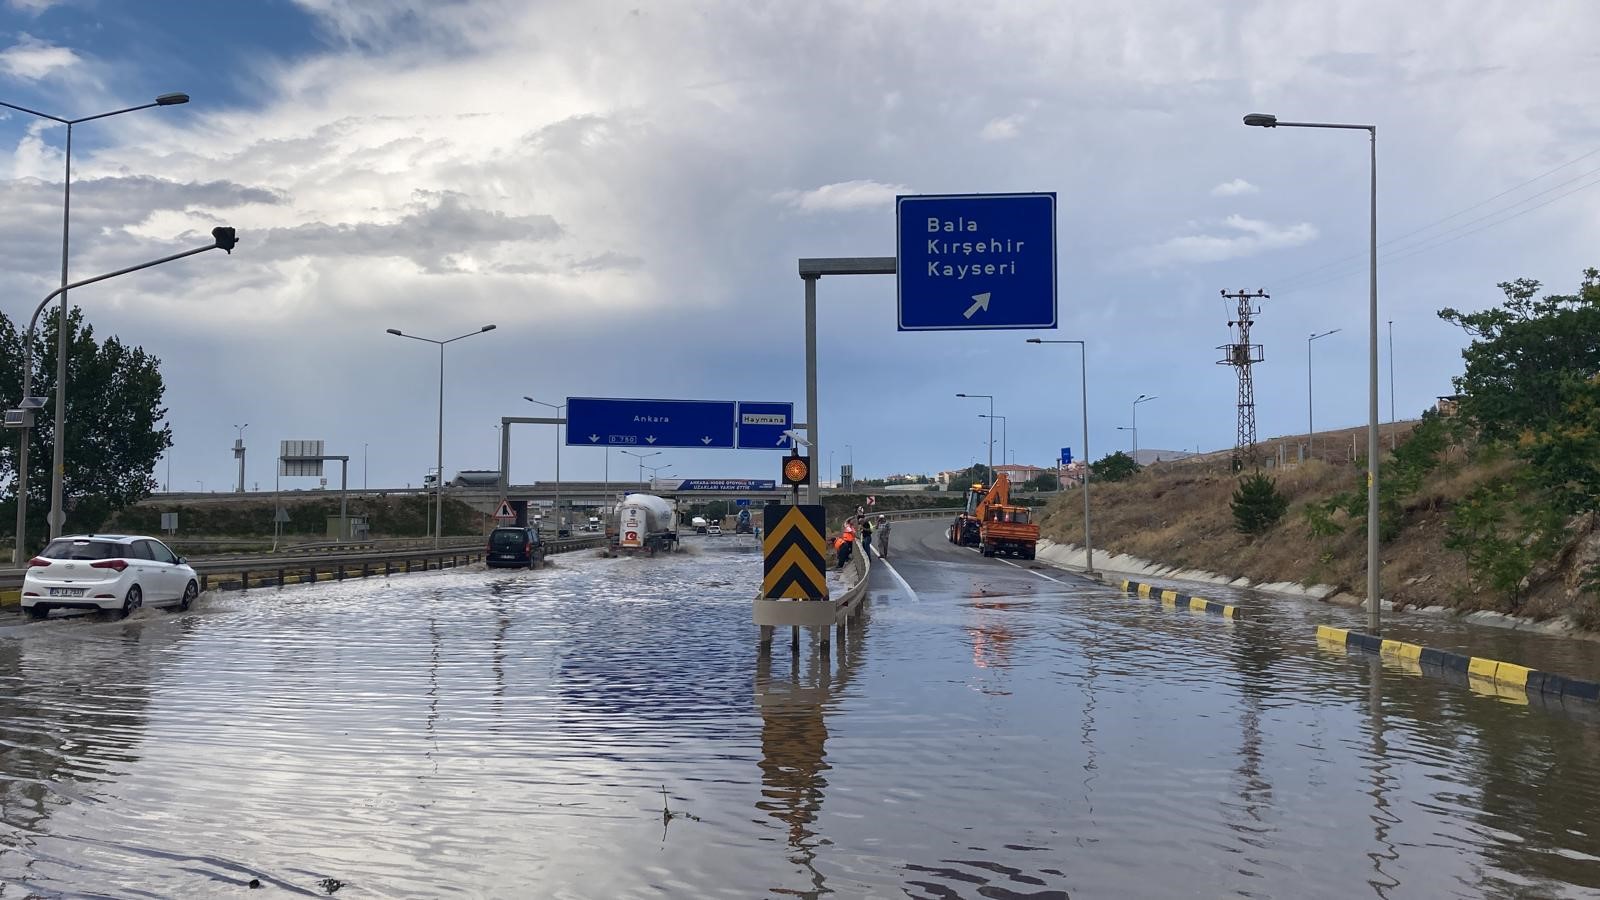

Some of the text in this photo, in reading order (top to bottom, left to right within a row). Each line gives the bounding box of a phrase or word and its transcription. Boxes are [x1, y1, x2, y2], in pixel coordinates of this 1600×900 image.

[927, 217, 978, 232] Bala
[927, 238, 1025, 256] Kırşehir
[927, 261, 1016, 280] Kayseri
[633, 415, 670, 423] Ankara
[744, 416, 785, 424] Haymana
